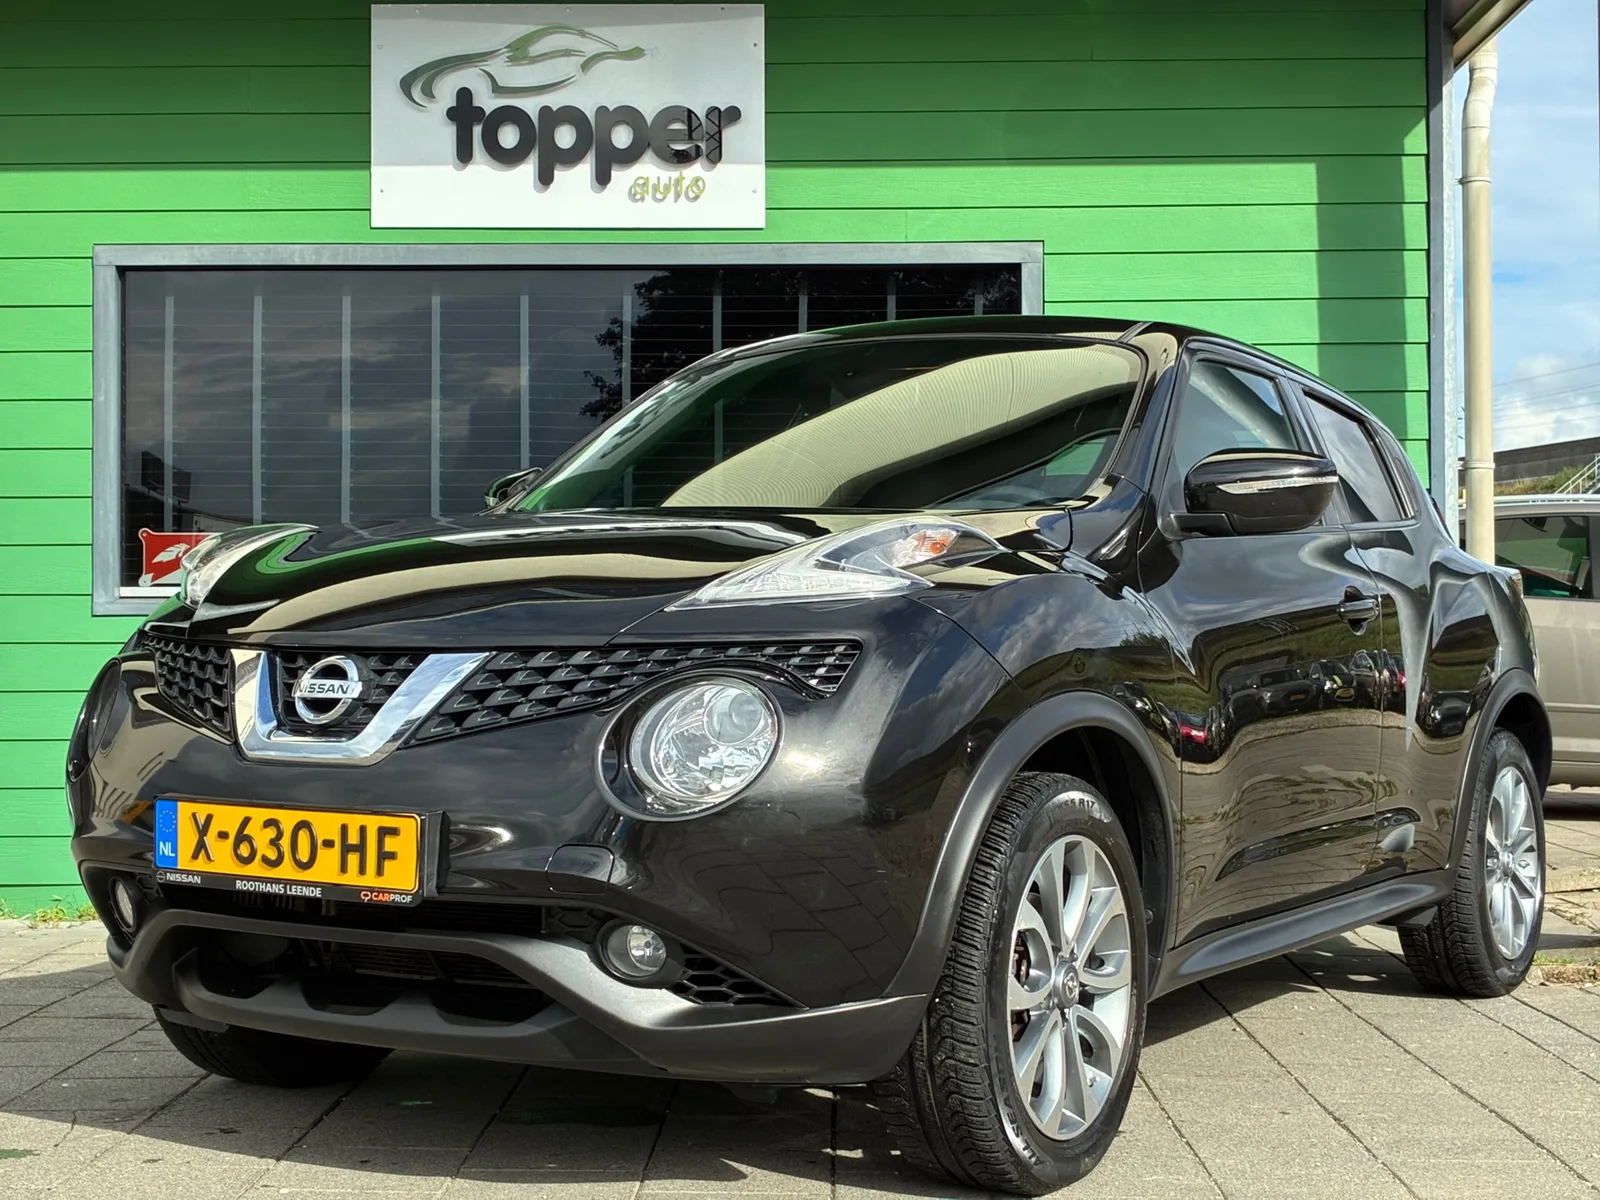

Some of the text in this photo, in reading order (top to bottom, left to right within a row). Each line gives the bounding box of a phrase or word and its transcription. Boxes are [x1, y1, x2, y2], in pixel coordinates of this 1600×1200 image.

[446, 87, 742, 186] topper
[631, 171, 706, 199] auto
[297, 683, 350, 695] NISSAN
[159, 841, 176, 858] NL
[189, 811, 401, 877] X-630-HF
[166, 872, 201, 884] NISSAN
[235, 879, 322, 898] ROOTHANS LEENDE
[371, 891, 413, 903] CARPROF
